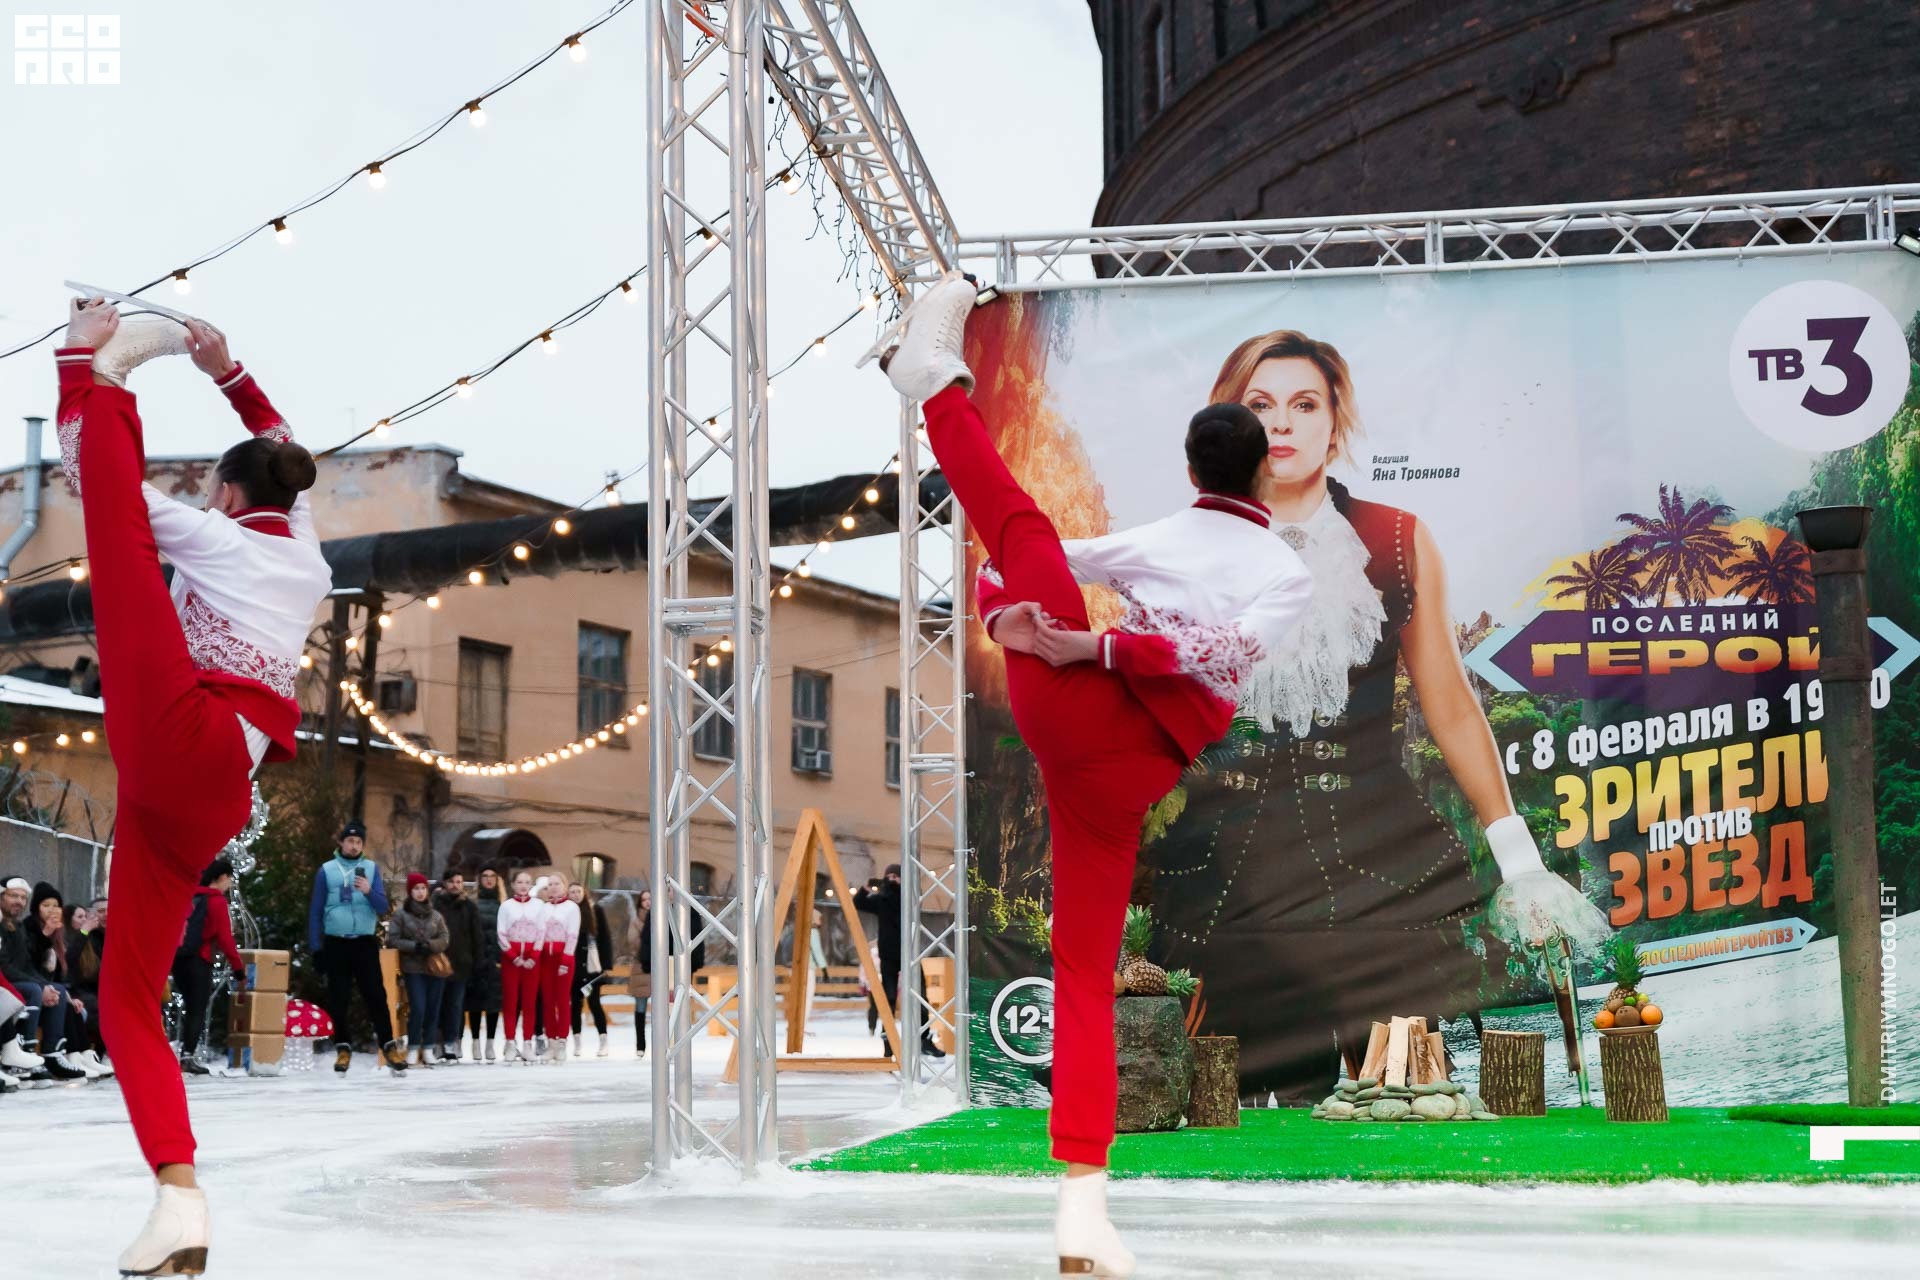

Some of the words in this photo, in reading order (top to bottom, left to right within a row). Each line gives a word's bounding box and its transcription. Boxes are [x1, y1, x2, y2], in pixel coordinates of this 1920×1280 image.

[1372, 455, 1409, 464] Ведущая
[1372, 467, 1396, 481] Яна
[1400, 467, 1460, 481] Троянова
[1592, 608, 1779, 634] ПОСЛЕДНИЙ
[1532, 729, 1556, 770] 8
[1568, 703, 1734, 767] февраля
[1649, 806, 1752, 852] ПРОТИВ
[1608, 820, 1814, 927] ЗВЕЗД
